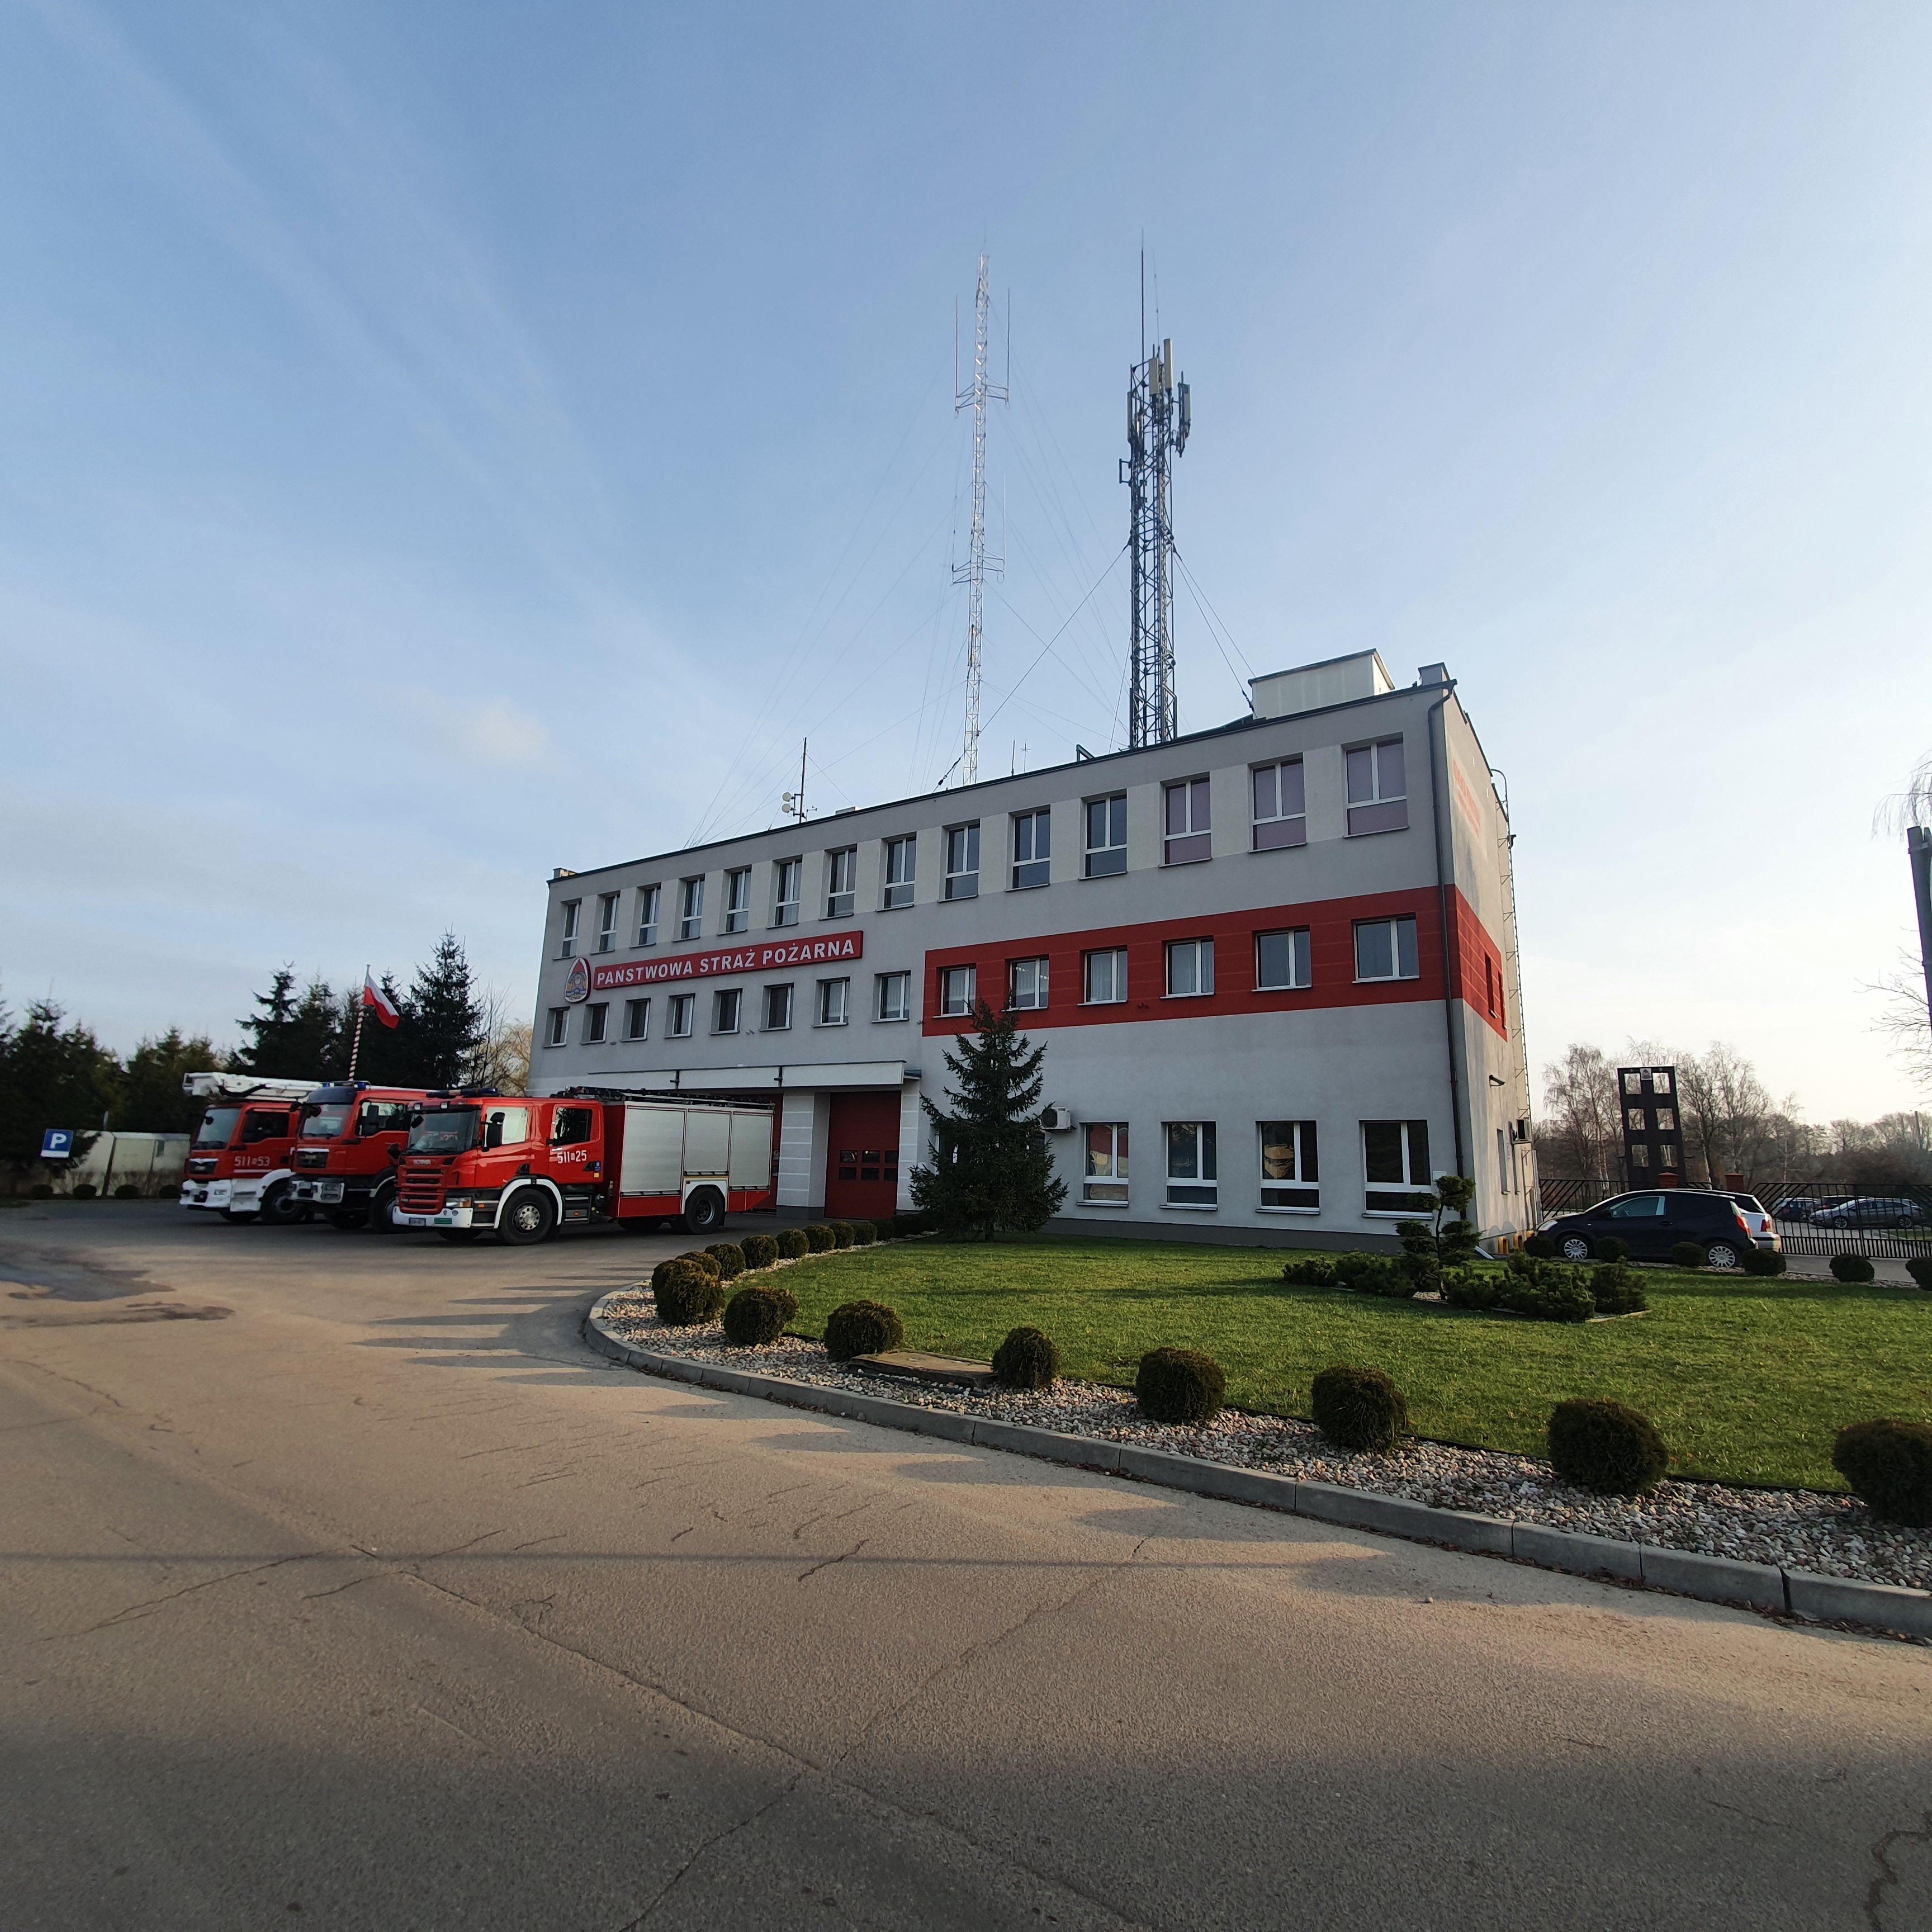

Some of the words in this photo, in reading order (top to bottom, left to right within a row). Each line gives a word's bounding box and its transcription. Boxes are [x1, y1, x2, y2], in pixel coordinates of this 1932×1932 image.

[596, 960, 693, 986] PAŃSTWOWA
[699, 948, 755, 973] STRAŻ
[763, 939, 854, 965] POŻARNA
[50, 1133, 67, 1149] P
